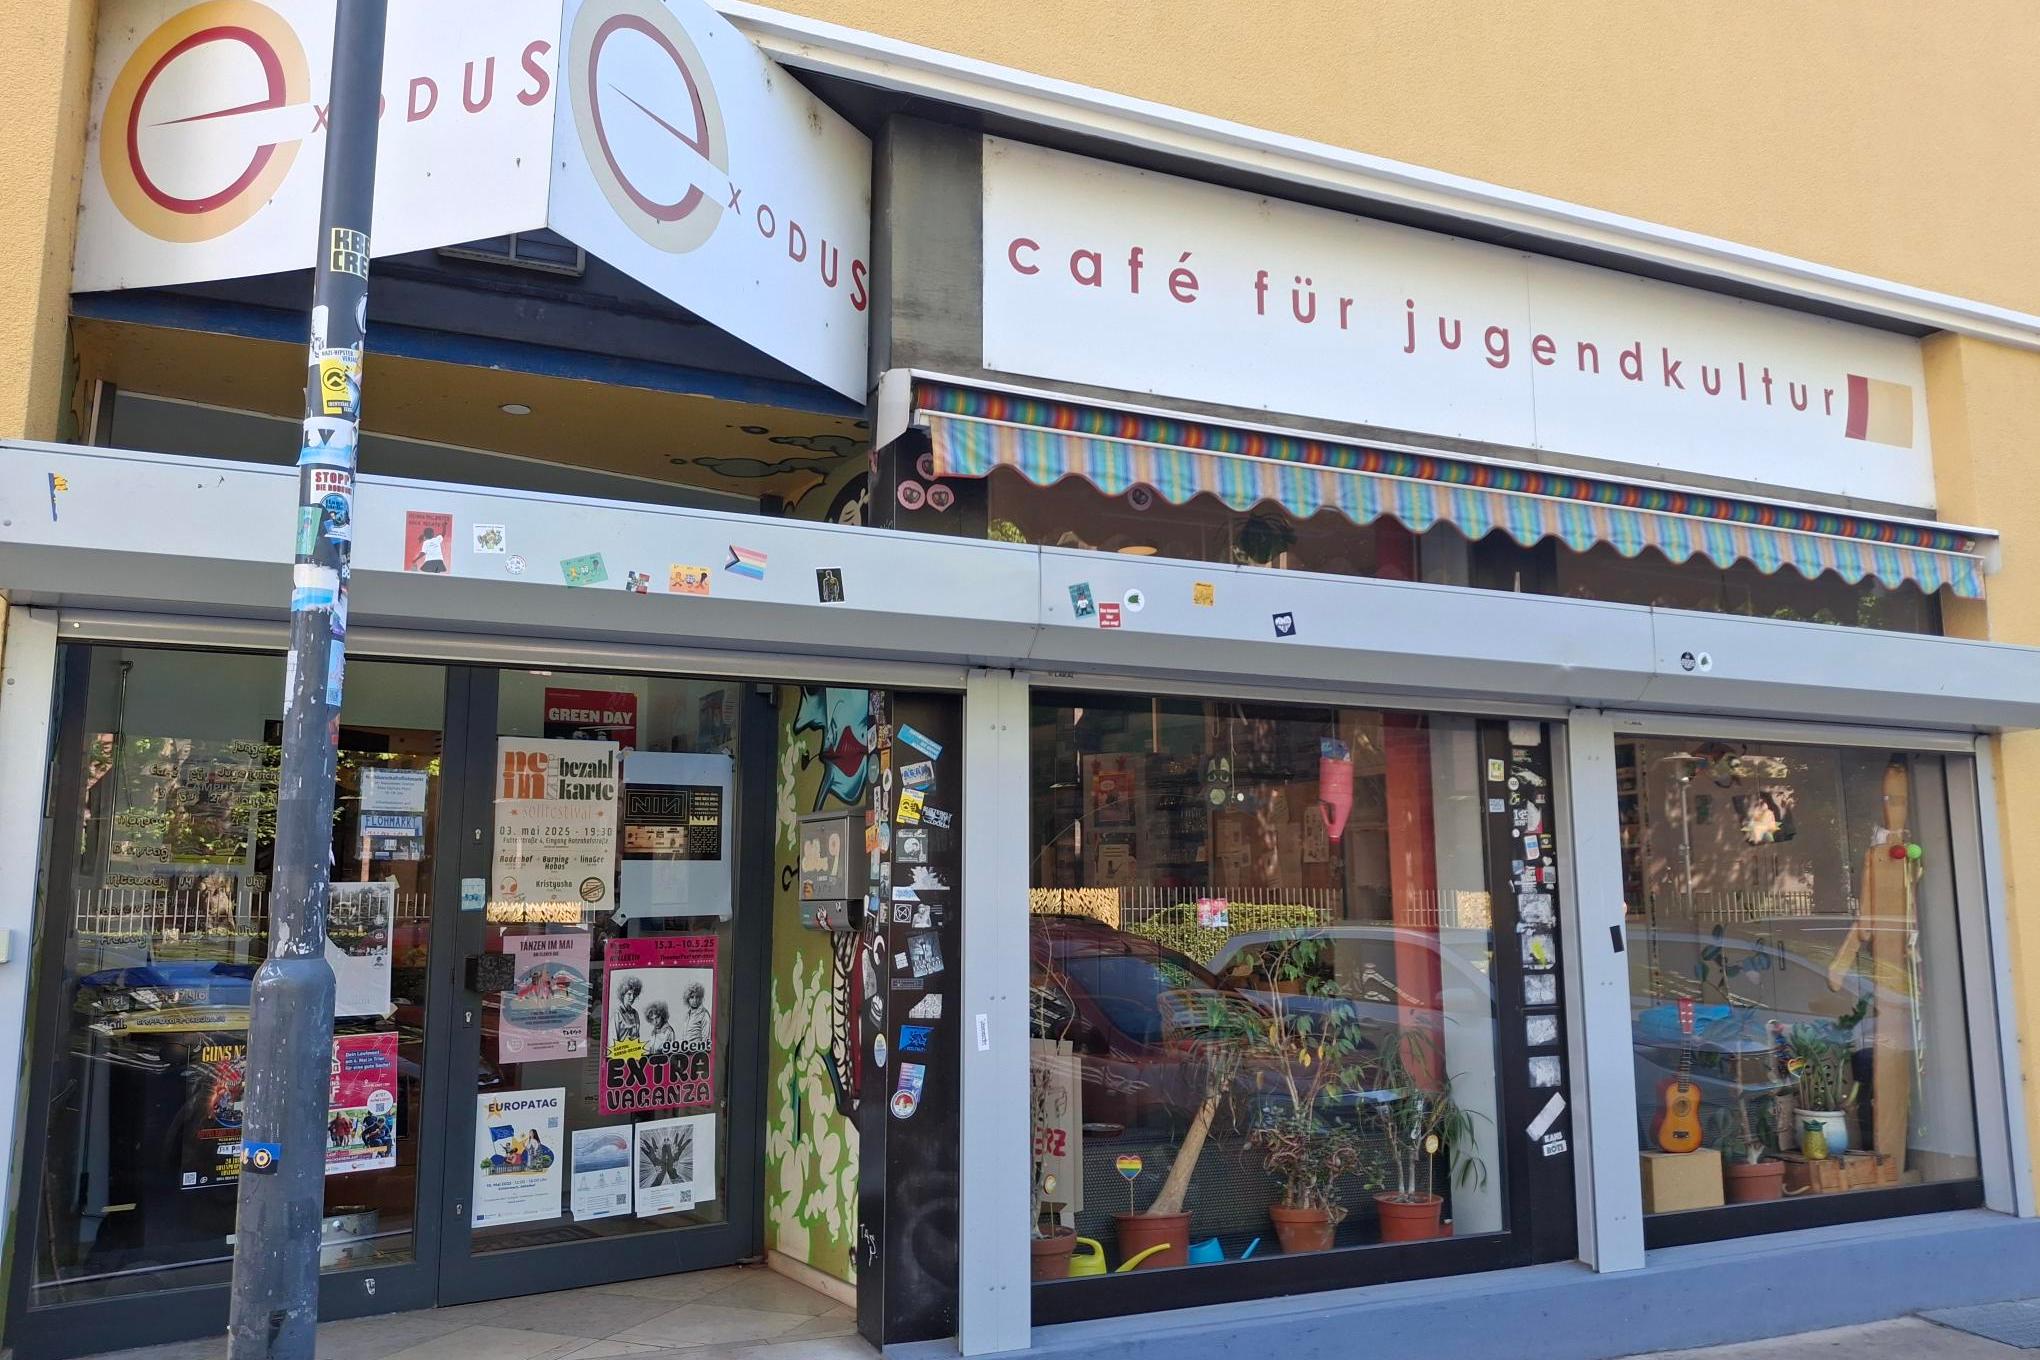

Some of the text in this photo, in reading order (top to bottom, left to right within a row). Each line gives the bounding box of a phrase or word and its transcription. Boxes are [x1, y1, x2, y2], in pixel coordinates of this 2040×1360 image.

[1007, 238, 1835, 418] café für jugendkultur
[315, 471, 350, 485] STOPP
[548, 707, 632, 725] GREEN DAY
[559, 750, 613, 778] bezahl
[559, 779, 614, 801] karte
[544, 826, 571, 836] 2025
[520, 939, 574, 951] TANZEN IM MAI
[201, 1046, 233, 1062] GUNS
[606, 1052, 711, 1089] EXTRA
[488, 1098, 558, 1113] EUROPATAG
[606, 1082, 711, 1112] VAGANZA
